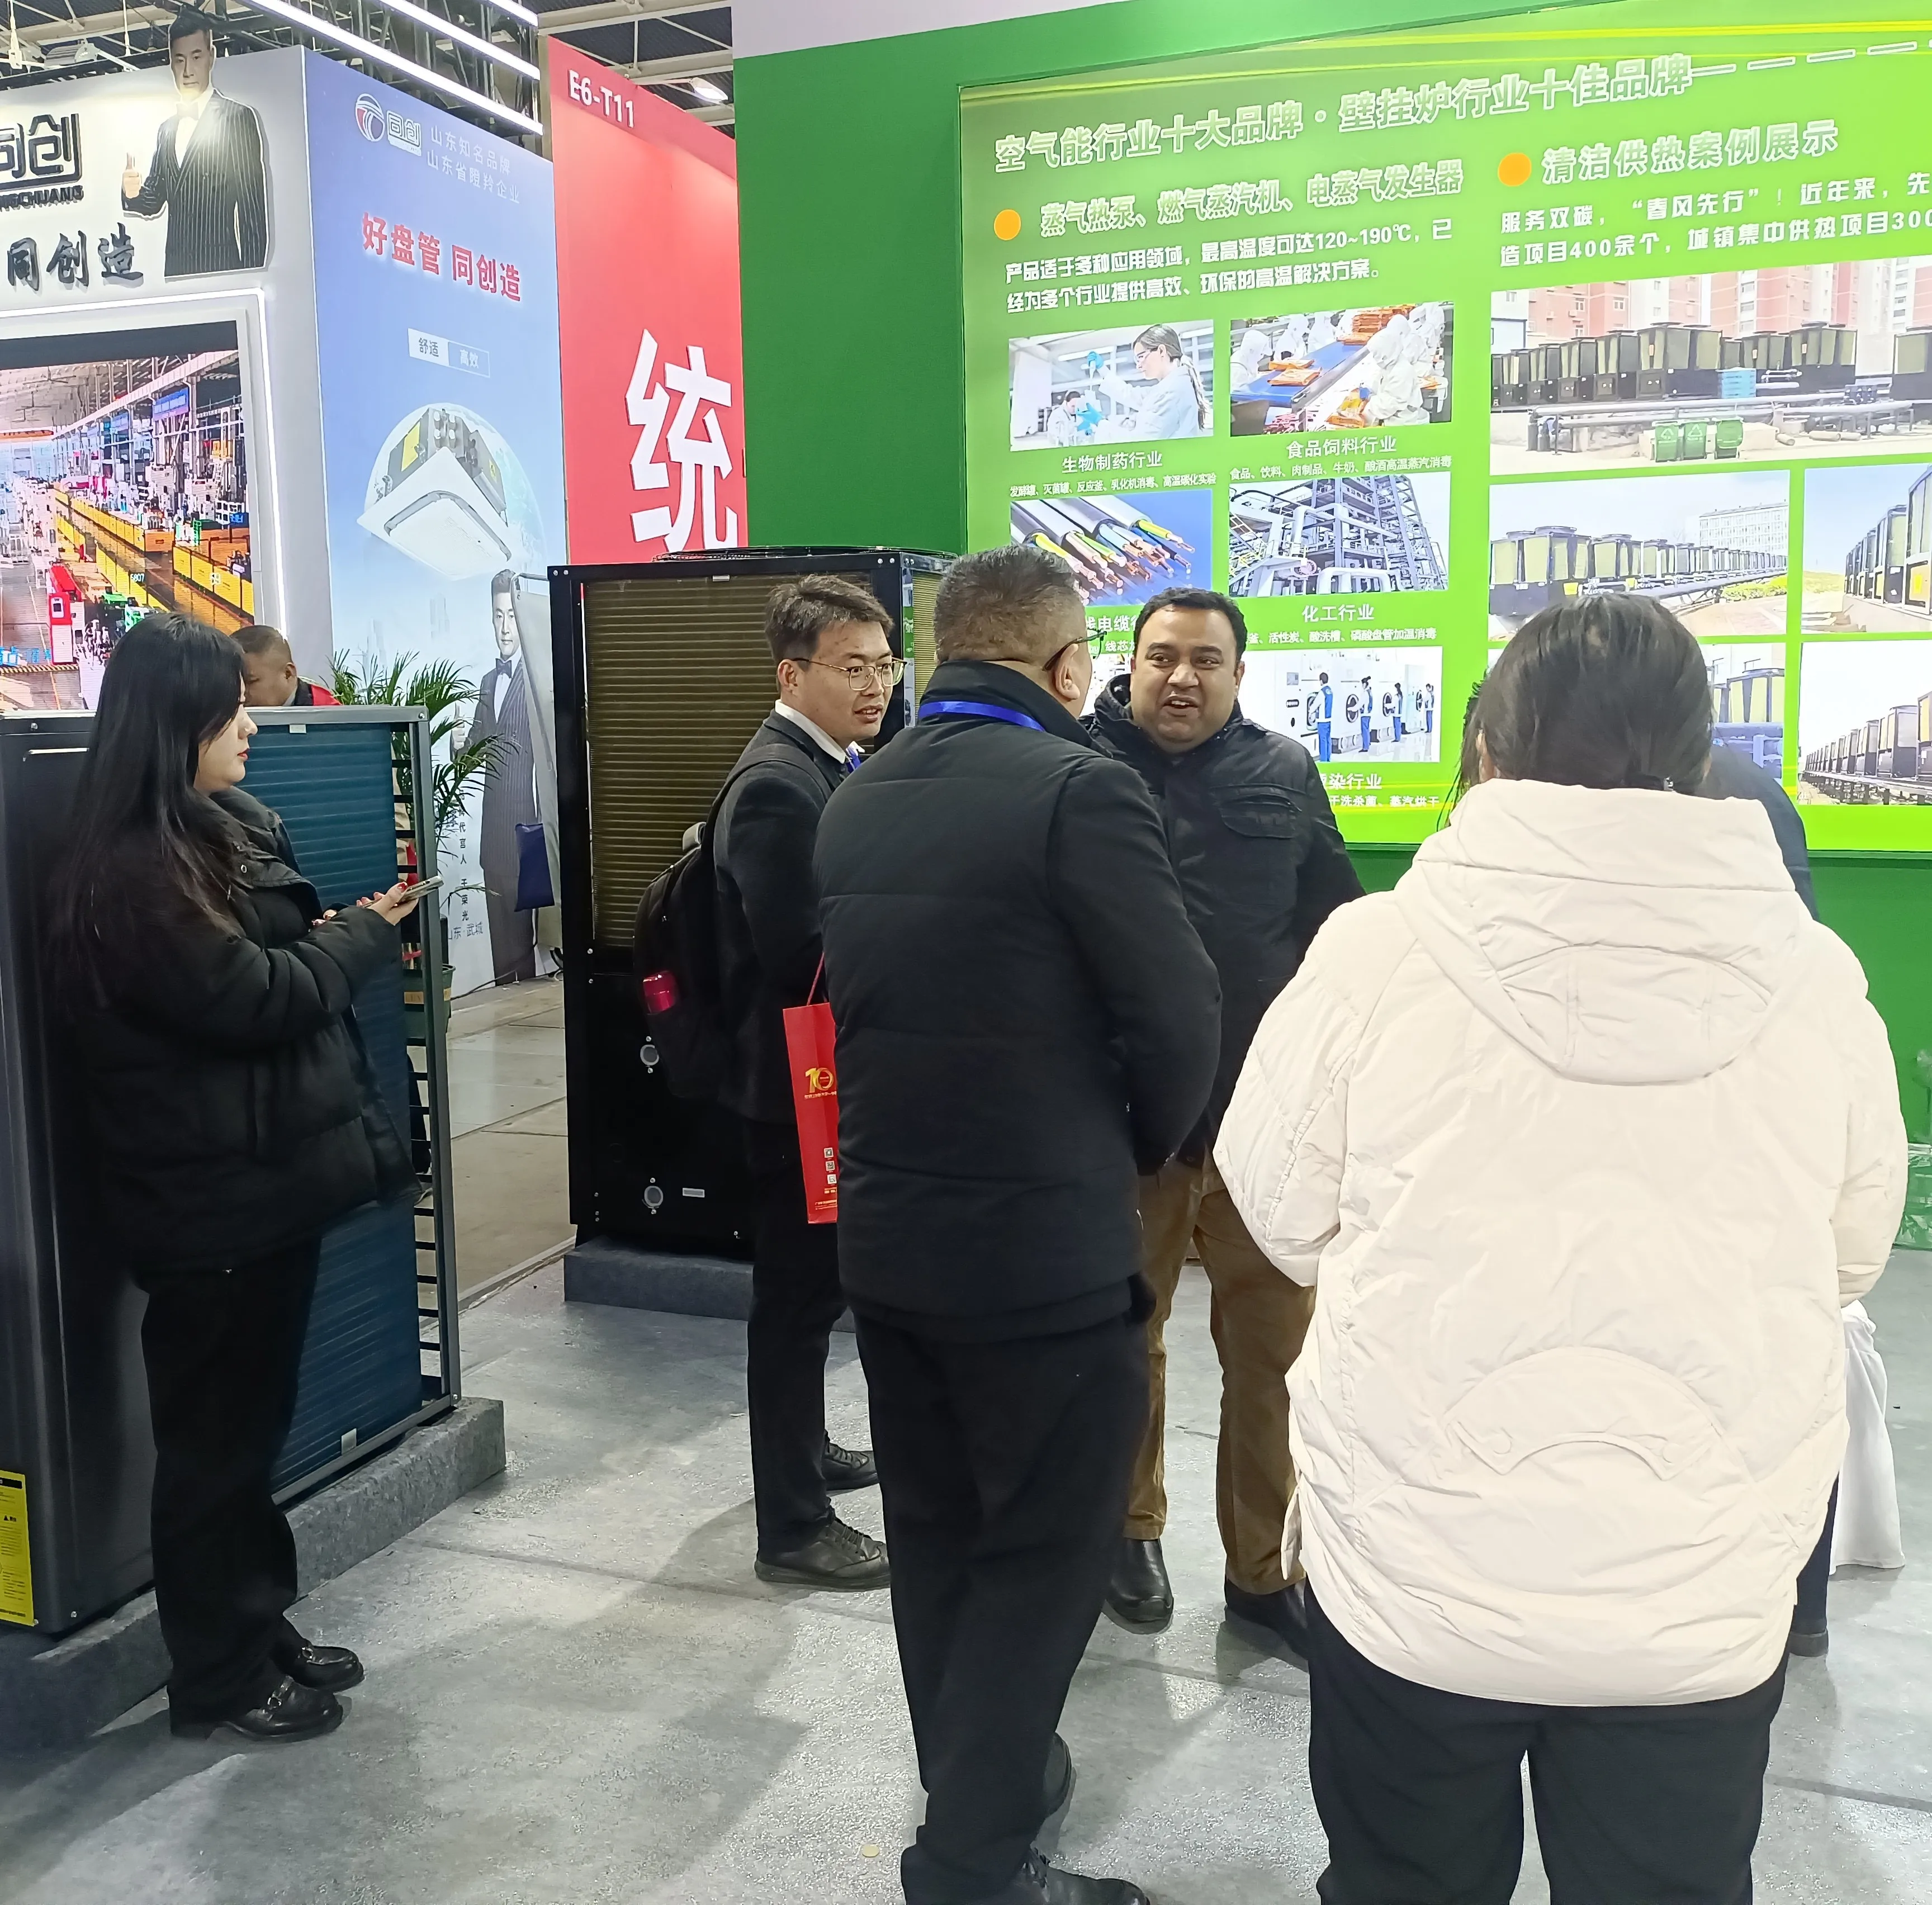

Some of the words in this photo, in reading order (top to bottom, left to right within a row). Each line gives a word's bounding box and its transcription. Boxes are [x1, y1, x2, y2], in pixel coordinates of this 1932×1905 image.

[568, 69, 634, 128] E6-T11
[427, 149, 520, 203] 山东省瞪羚企业
[430, 125, 511, 175] 山东知名品牌
[1541, 119, 1839, 184] 清洁供热案例展示
[7, 222, 144, 291] 同创造
[362, 211, 440, 275] 好盘管
[452, 244, 520, 301] 同创造
[418, 337, 439, 357] 舒适
[460, 349, 479, 369] 高效
[625, 328, 738, 553] 统
[1062, 450, 1163, 474] 生物制药行业
[1286, 435, 1397, 459] 食品饲料行业
[1301, 603, 1375, 623] 化工行业
